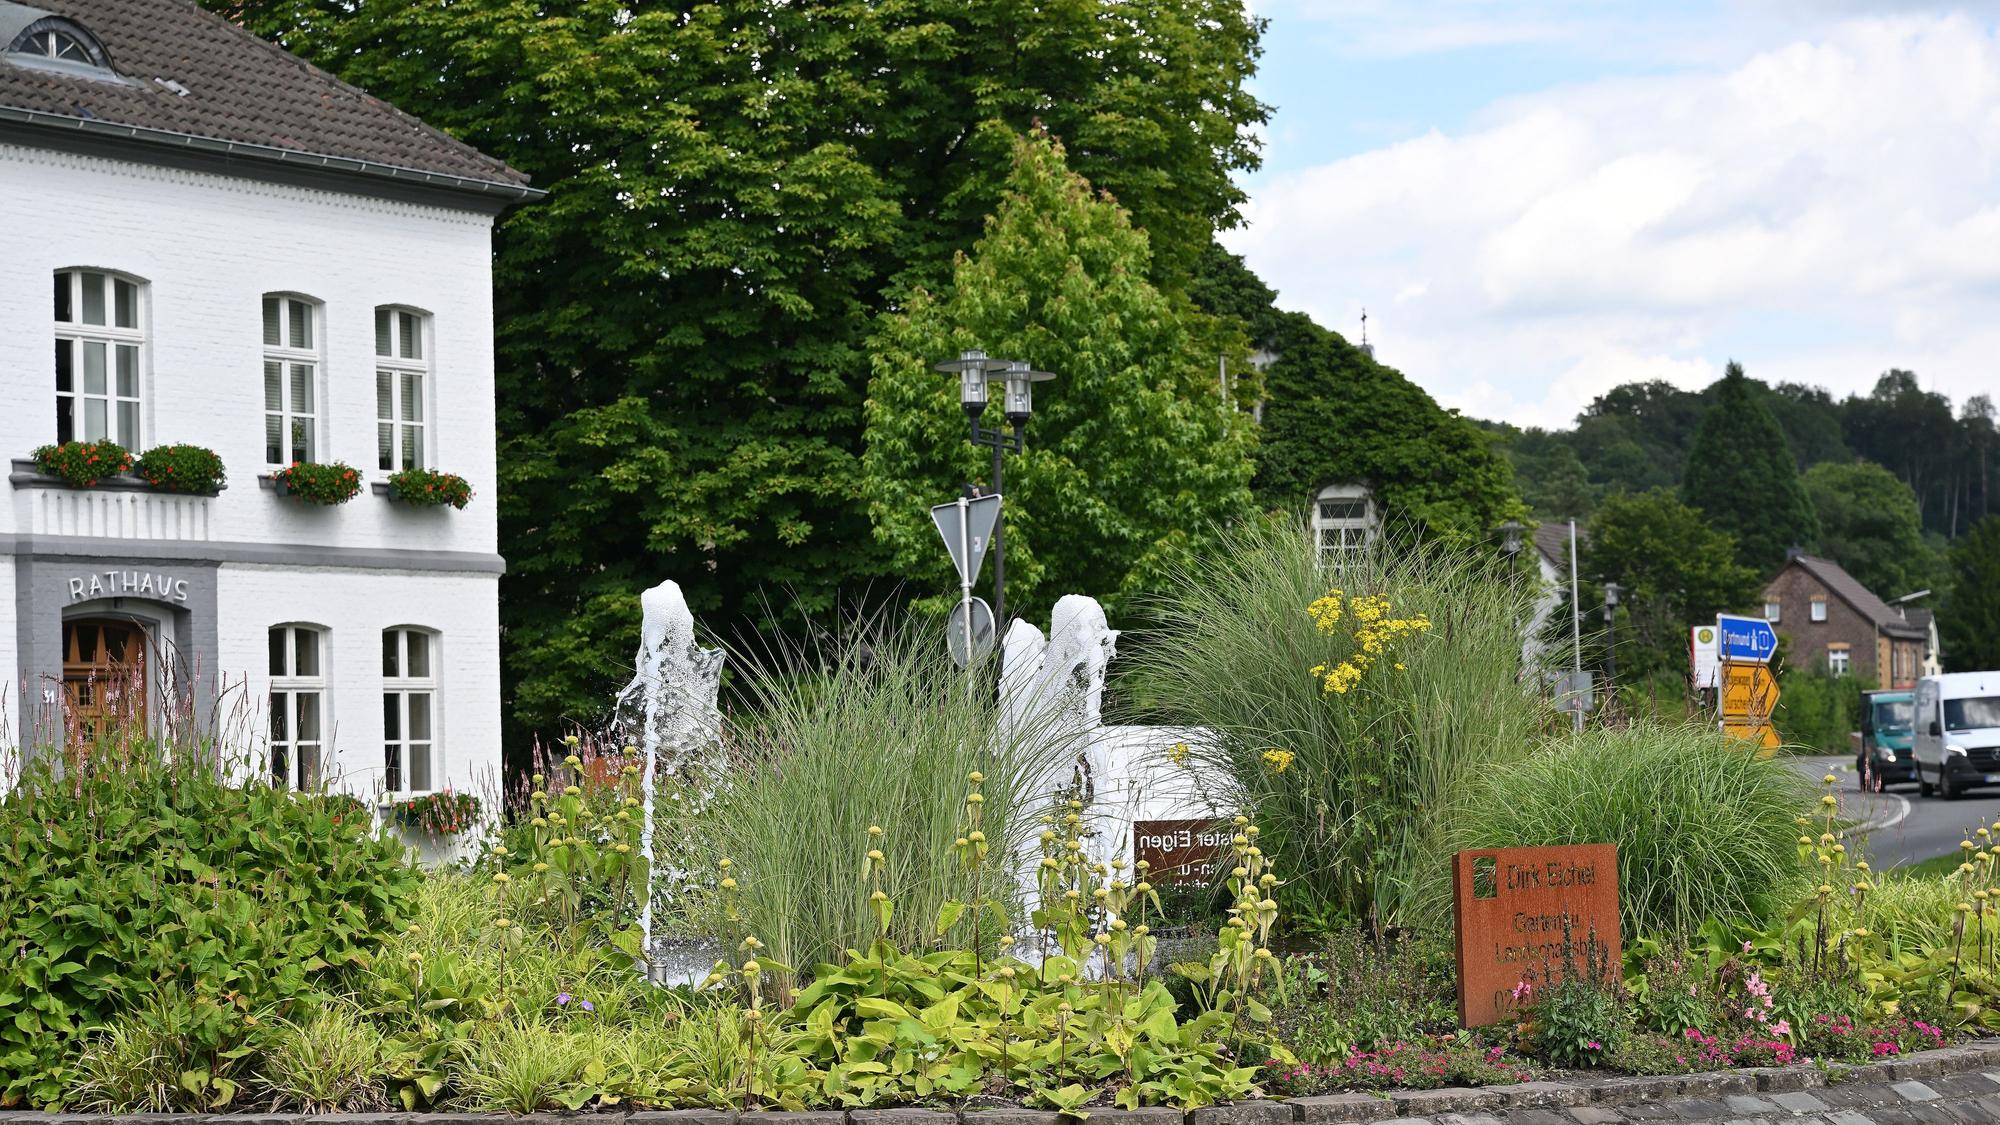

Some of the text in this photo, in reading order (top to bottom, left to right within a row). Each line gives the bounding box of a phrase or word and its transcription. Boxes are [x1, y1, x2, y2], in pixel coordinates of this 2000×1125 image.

[69, 570, 189, 600] RATHAUS
[43, 690, 54, 703] 31
[1507, 861, 1595, 890] Dirk Eichel
[1495, 936, 1605, 964] Landschasbu
